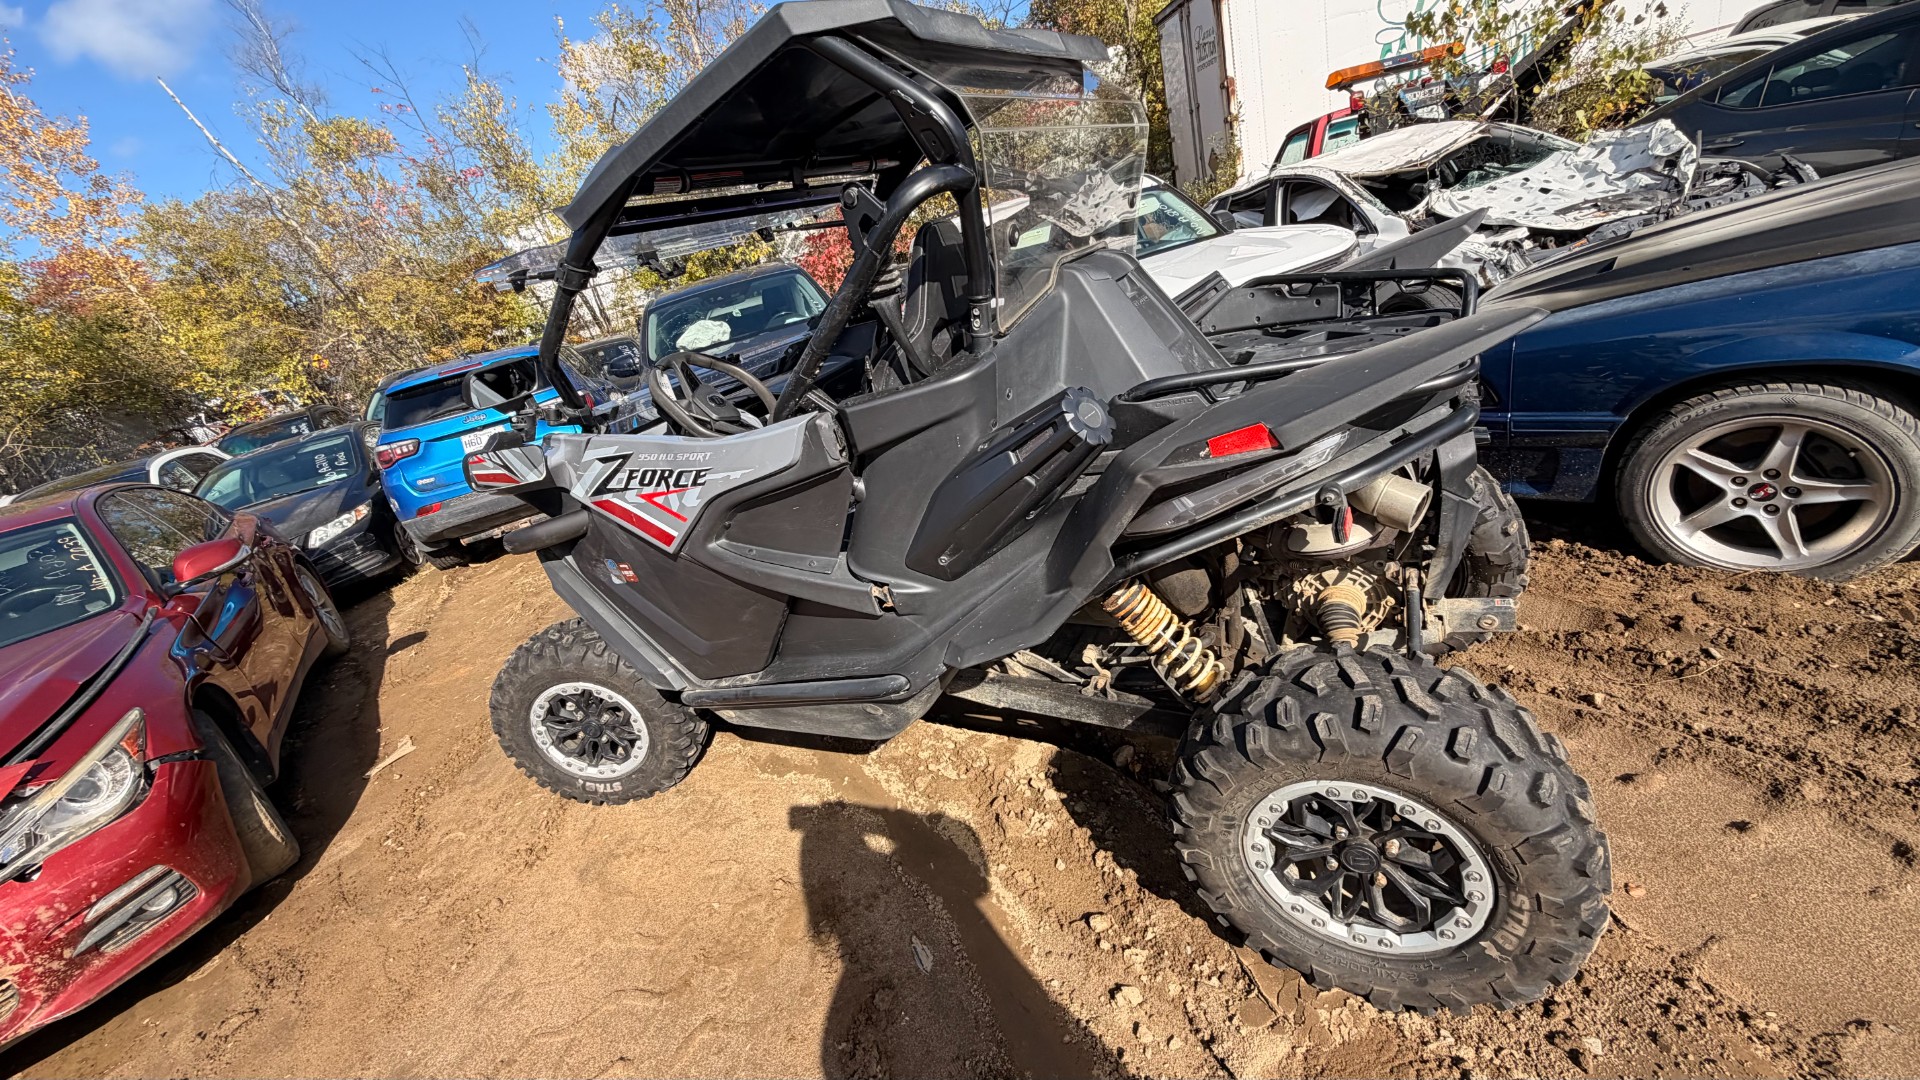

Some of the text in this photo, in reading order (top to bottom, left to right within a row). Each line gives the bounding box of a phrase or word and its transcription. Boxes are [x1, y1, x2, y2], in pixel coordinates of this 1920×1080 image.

[463, 413, 487, 424] Jeep
[638, 453, 657, 462] 950
[677, 452, 713, 463] SPORT
[57, 536, 88, 561] 2039
[75, 563, 96, 572] A
[585, 780, 623, 793] STAG
[1492, 890, 1532, 952] STAG
